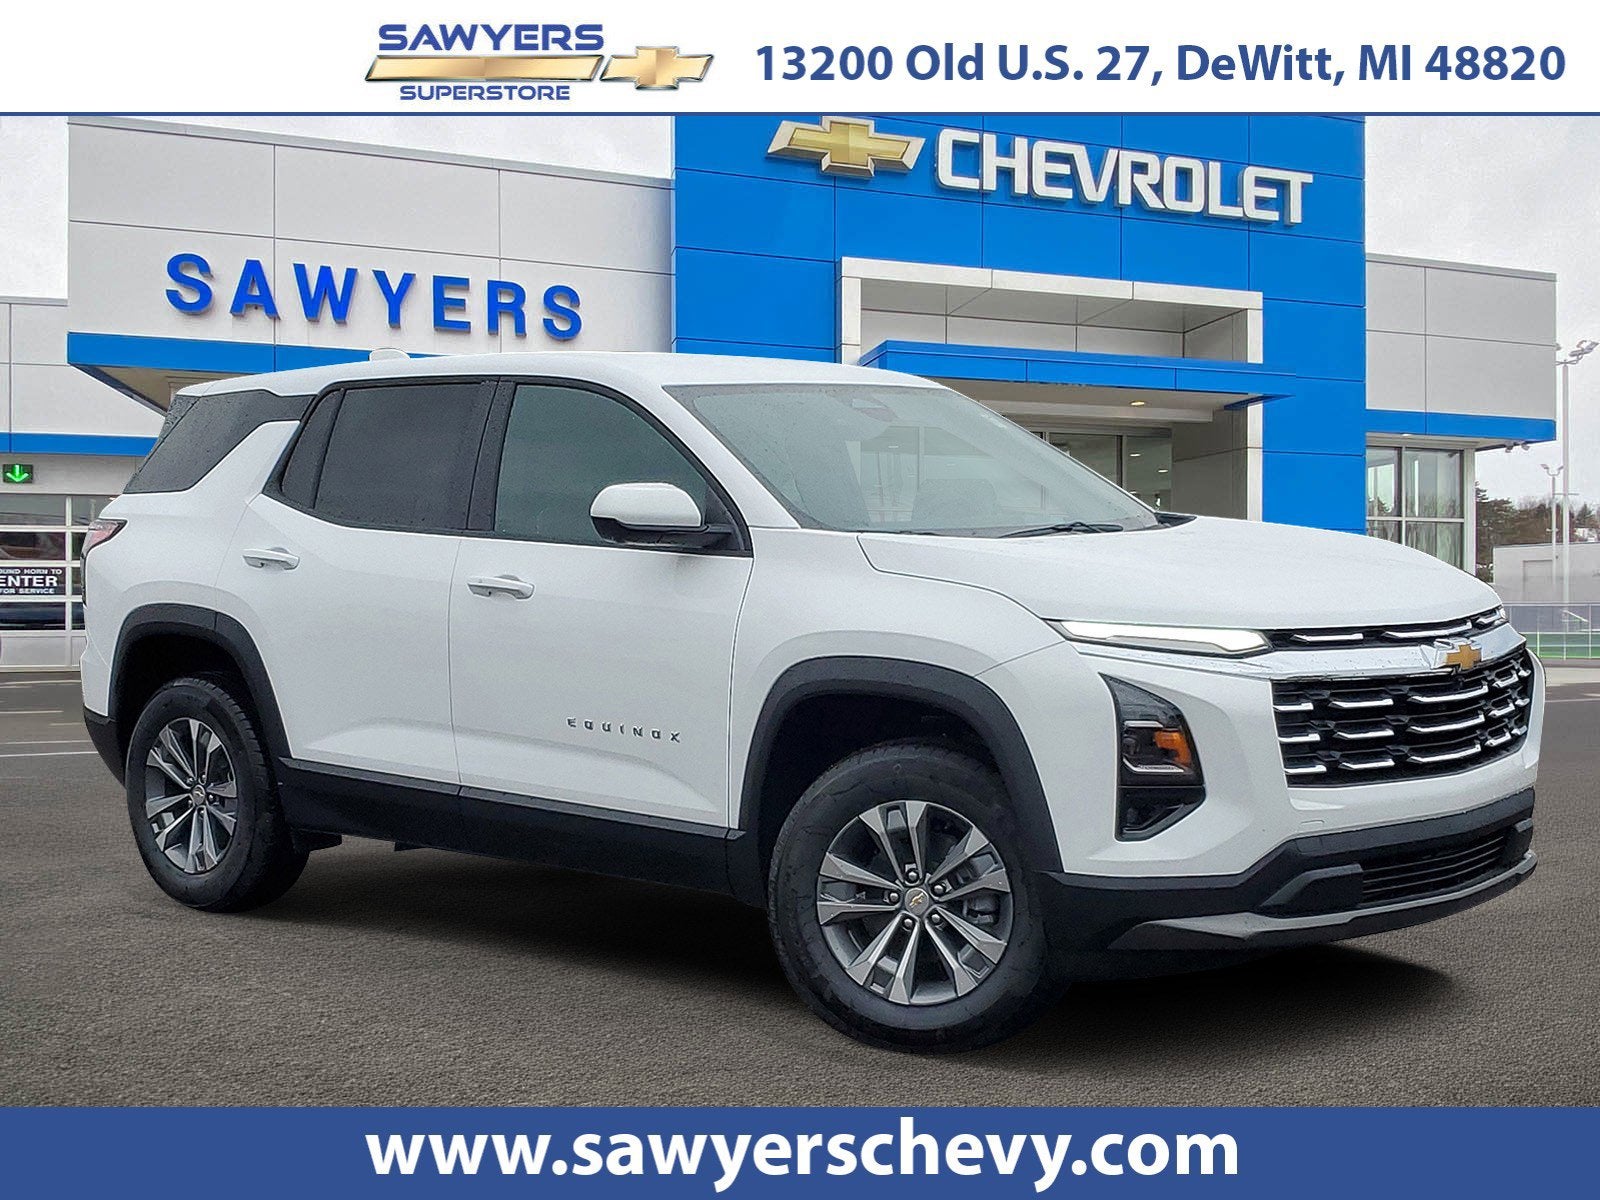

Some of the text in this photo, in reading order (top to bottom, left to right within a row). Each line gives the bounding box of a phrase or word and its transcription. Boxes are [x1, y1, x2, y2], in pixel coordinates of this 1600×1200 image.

[936, 128, 1314, 226] CHEVROLET
[165, 253, 583, 341] SAWYERS
[0, 575, 58, 587] ENTER
[566, 716, 681, 743] EQUINOX
